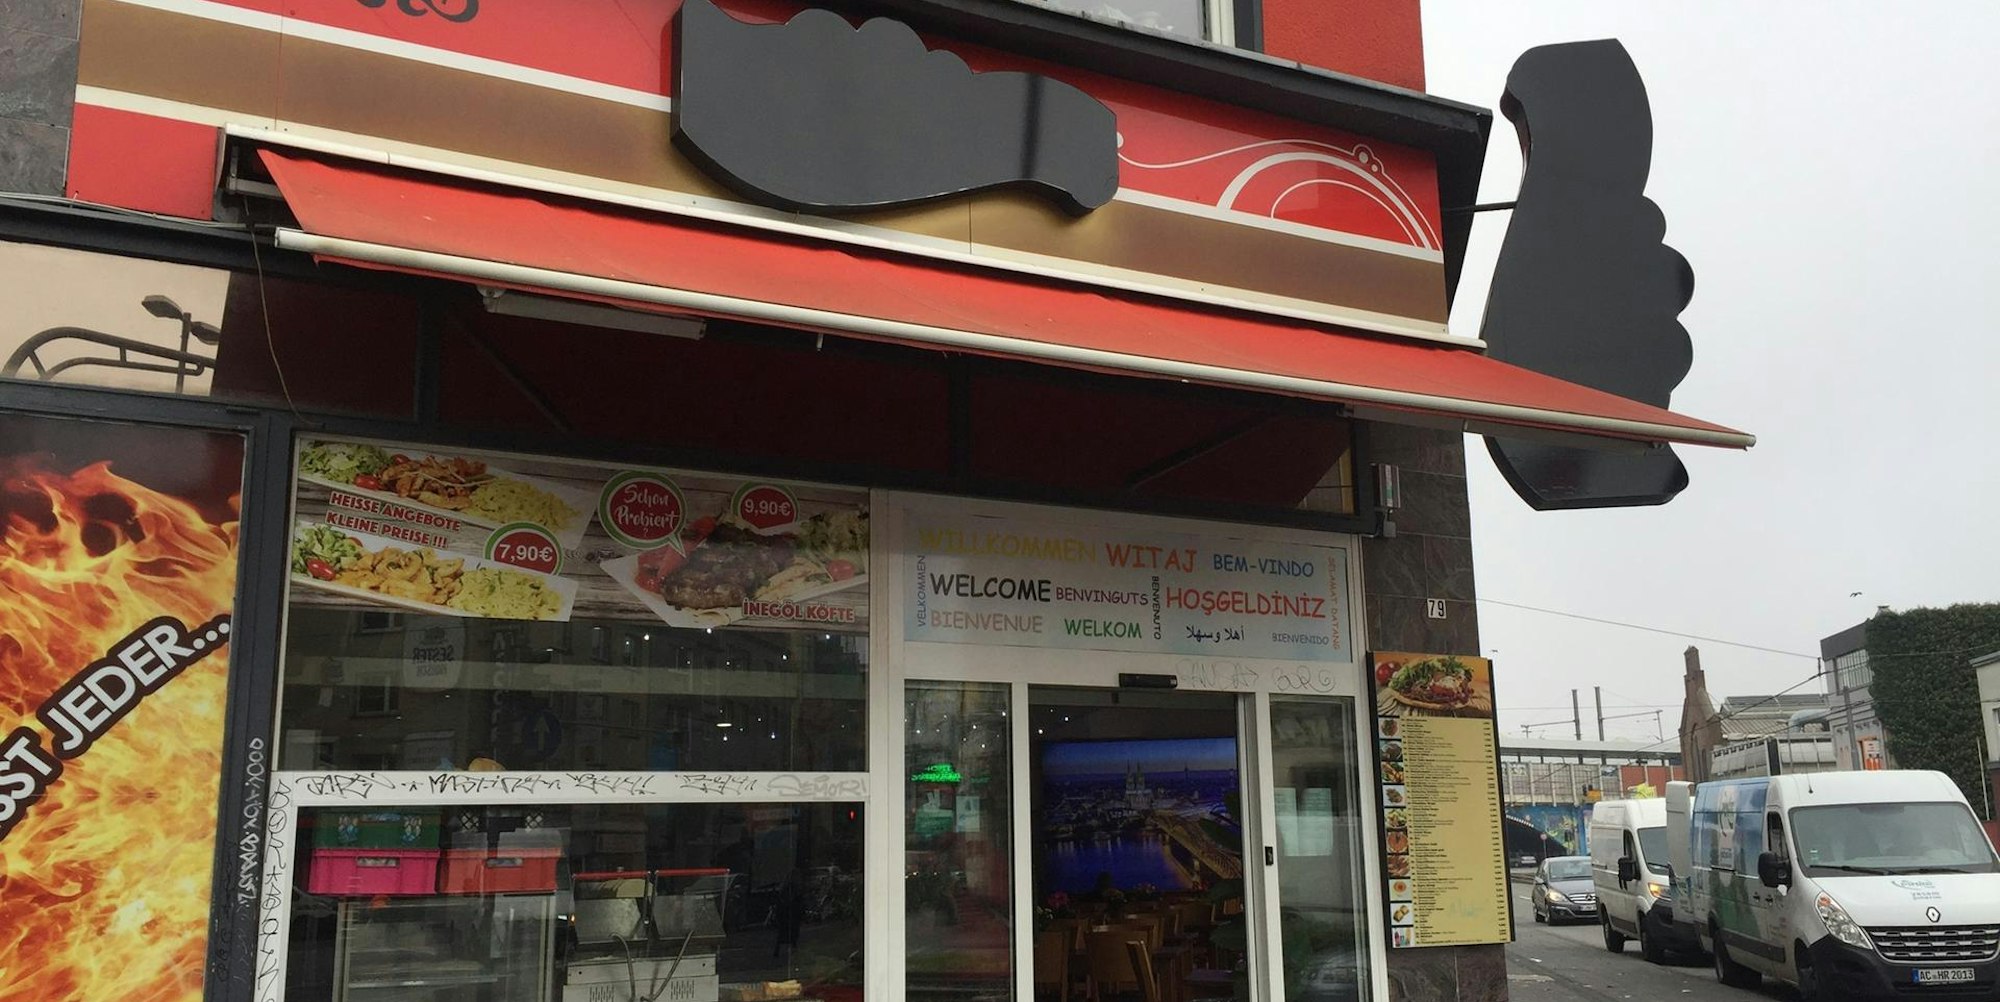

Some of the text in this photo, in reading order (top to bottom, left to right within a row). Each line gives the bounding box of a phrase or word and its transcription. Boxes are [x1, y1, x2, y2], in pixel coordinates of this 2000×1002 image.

[623, 484, 669, 508] Schon
[744, 499, 792, 517] 9,90€
[329, 491, 461, 532] HEISSE ANGEBOTE
[614, 504, 678, 530] Probiert
[325, 512, 448, 549] KLEINE PREISE !!!
[499, 543, 553, 562] 7,90€
[918, 527, 1096, 563] WILLKOMMEN
[1106, 543, 1198, 573] WITAJ
[1213, 554, 1314, 577] BEM-VINDO
[917, 555, 926, 627] VELKOMMEN
[930, 573, 1051, 602] WELCOME
[1056, 587, 1148, 605] BENVINGUTS
[742, 598, 855, 623] İNEGÖL KÖFTE
[1152, 576, 1161, 640] BENVENUTO
[1166, 587, 1326, 618] HOŞGELDİNİZ
[1429, 600, 1444, 617] 79
[930, 610, 1043, 633] BIENVENUE
[1064, 618, 1142, 640] WELKOM
[1272, 632, 1329, 645] BIENVENIDO
[1951, 970, 1974, 980] 2013
